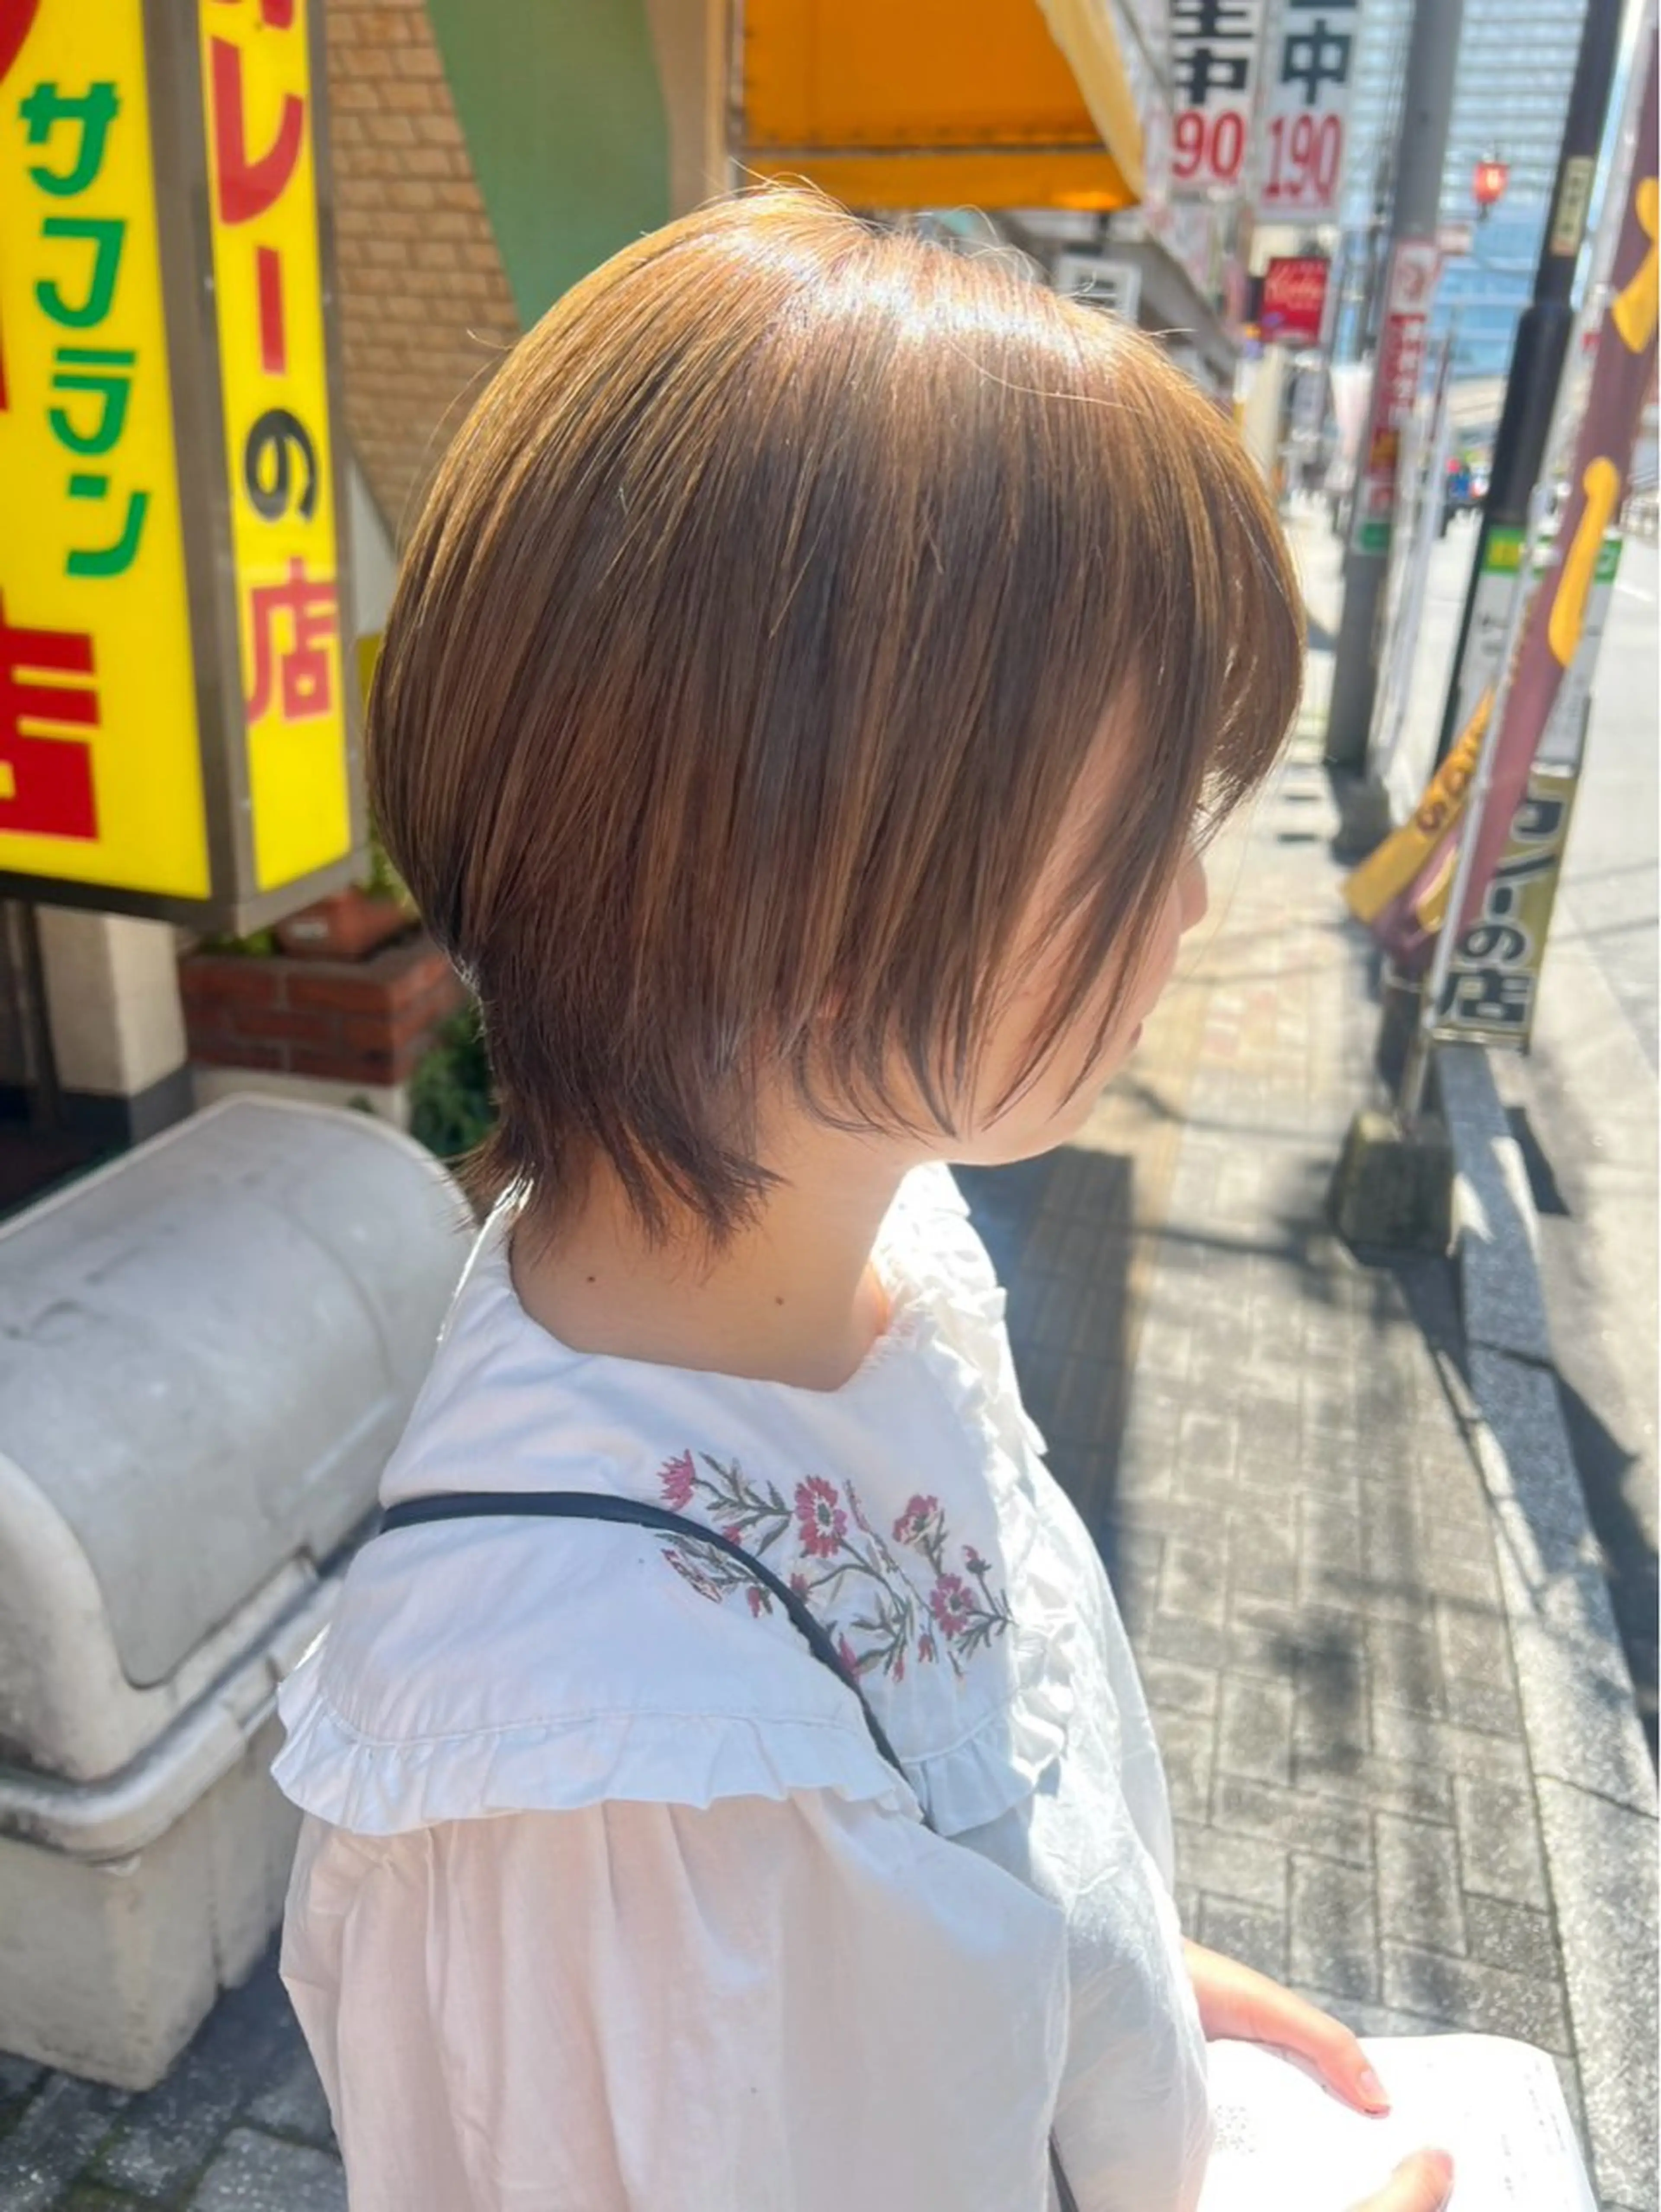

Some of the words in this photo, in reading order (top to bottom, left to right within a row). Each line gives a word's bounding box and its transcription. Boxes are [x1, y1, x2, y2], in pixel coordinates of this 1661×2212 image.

[1263, 113, 1342, 203] 190
[1281, 0, 1357, 106] 中
[18, 81, 151, 578] サフラン
[208, 0, 337, 726] レーの店
